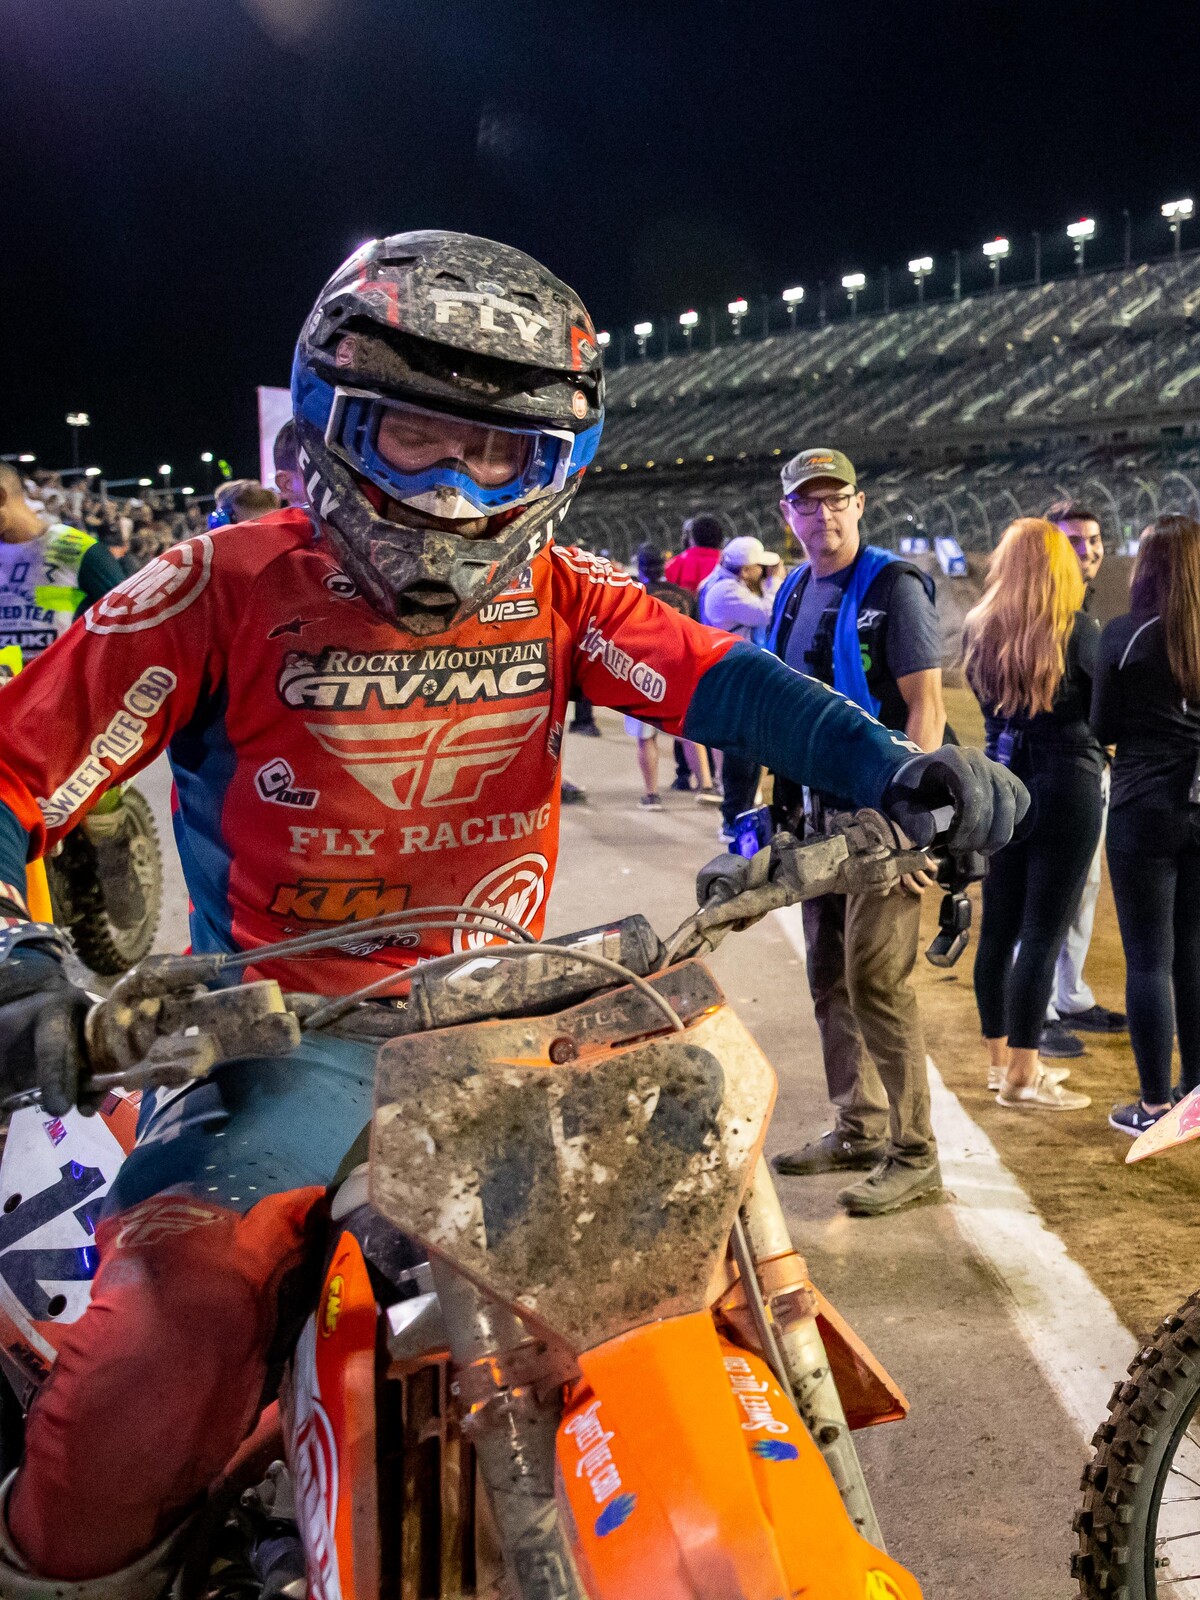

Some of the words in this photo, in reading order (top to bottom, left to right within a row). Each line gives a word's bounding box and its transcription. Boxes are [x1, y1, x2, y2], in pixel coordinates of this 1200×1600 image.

[435, 301, 543, 343] FLY
[479, 600, 539, 622] WPS
[323, 651, 416, 673] ROCKY
[420, 643, 543, 671] MOUNTAIN
[631, 665, 663, 700] CBD
[44, 760, 105, 827] SWEET
[96, 714, 143, 760] LIFE
[128, 669, 175, 714] CBD
[289, 825, 384, 856] FLY
[399, 802, 552, 855] RACING
[268, 878, 412, 922] KTM
